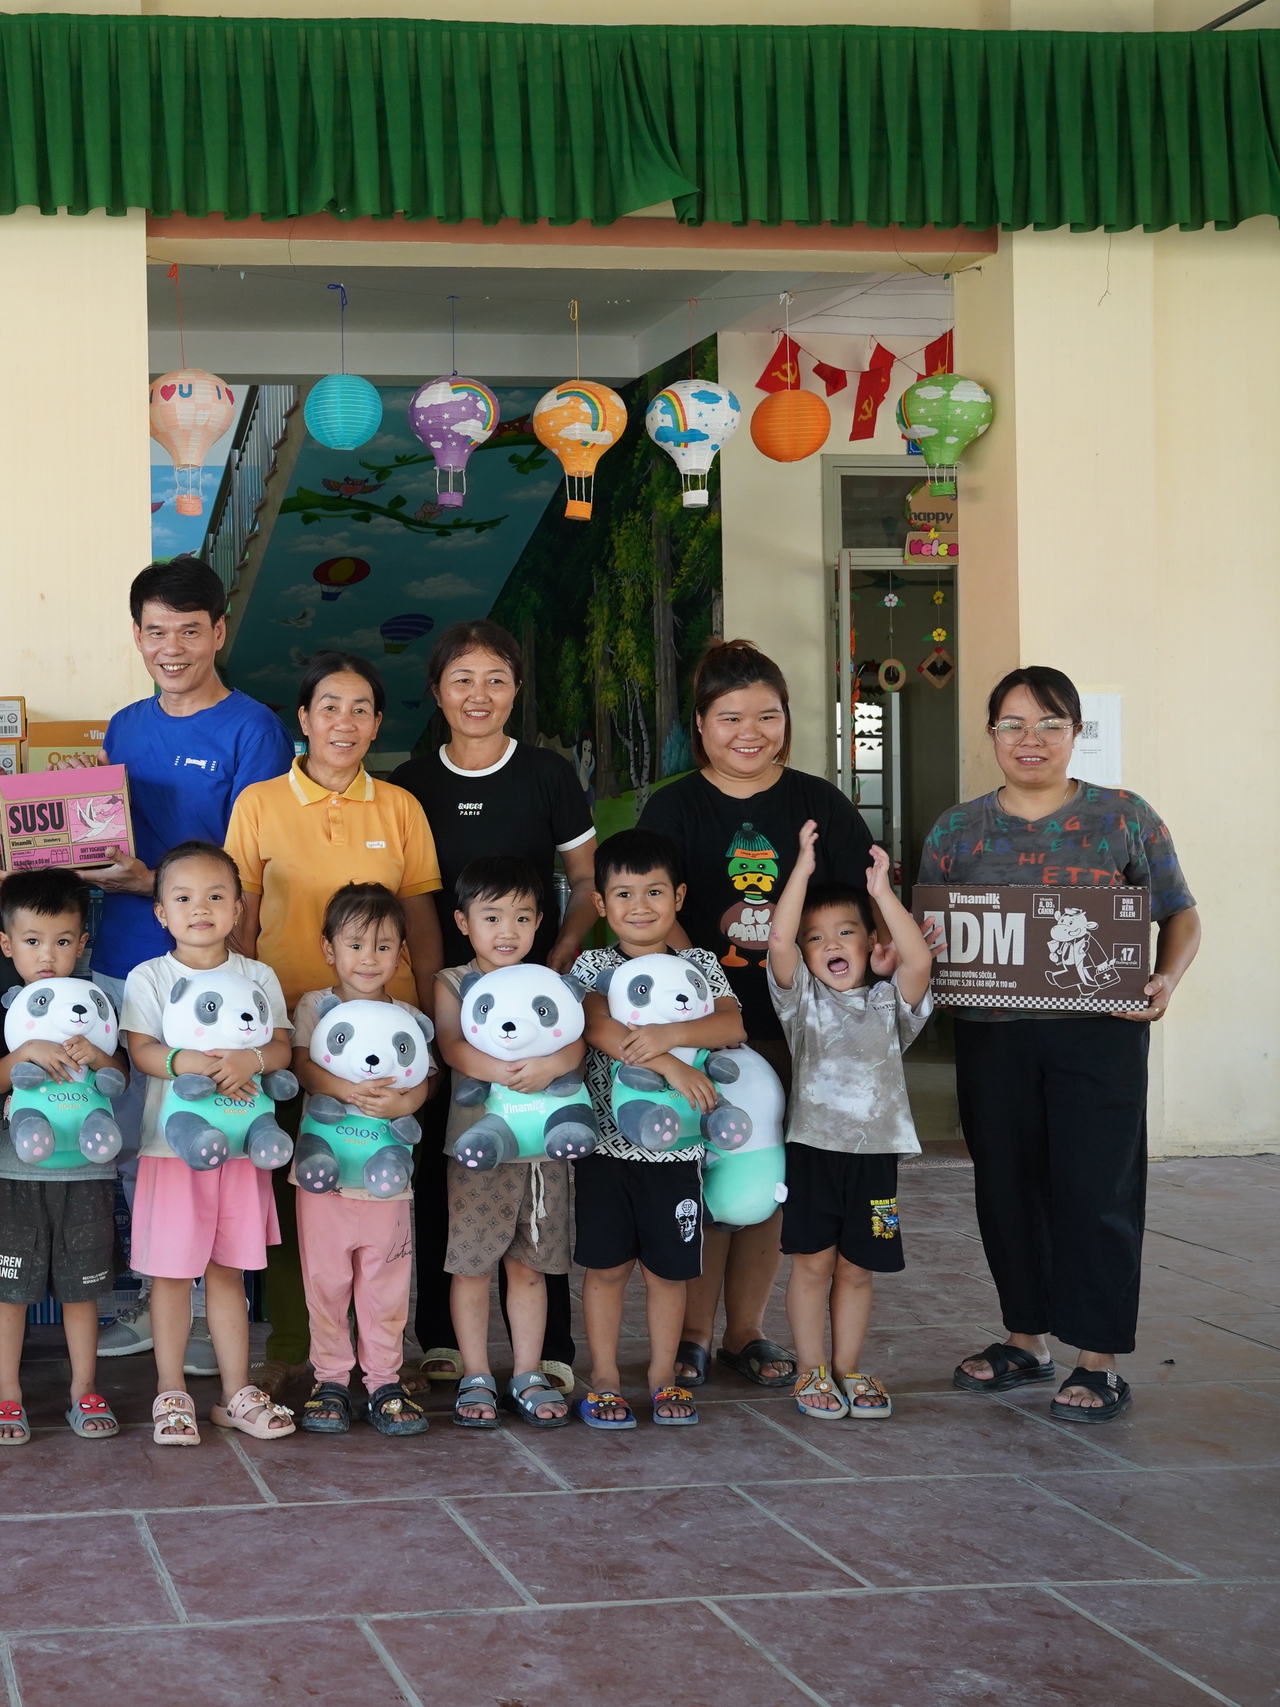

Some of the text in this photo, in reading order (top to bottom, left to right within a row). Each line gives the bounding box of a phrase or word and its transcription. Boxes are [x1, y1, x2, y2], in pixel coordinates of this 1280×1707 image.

[179, 383, 192, 398] U
[909, 539, 959, 557] Welco
[8, 801, 65, 834] SUSU
[11, 839, 32, 847] Vinamilk
[948, 892, 1000, 905] Vinamilk
[727, 921, 773, 942] MAD
[923, 910, 1026, 966] ADM
[1121, 947, 1135, 962] 17
[47, 1092, 89, 1103] COLOS
[335, 1125, 380, 1141] COLOS
